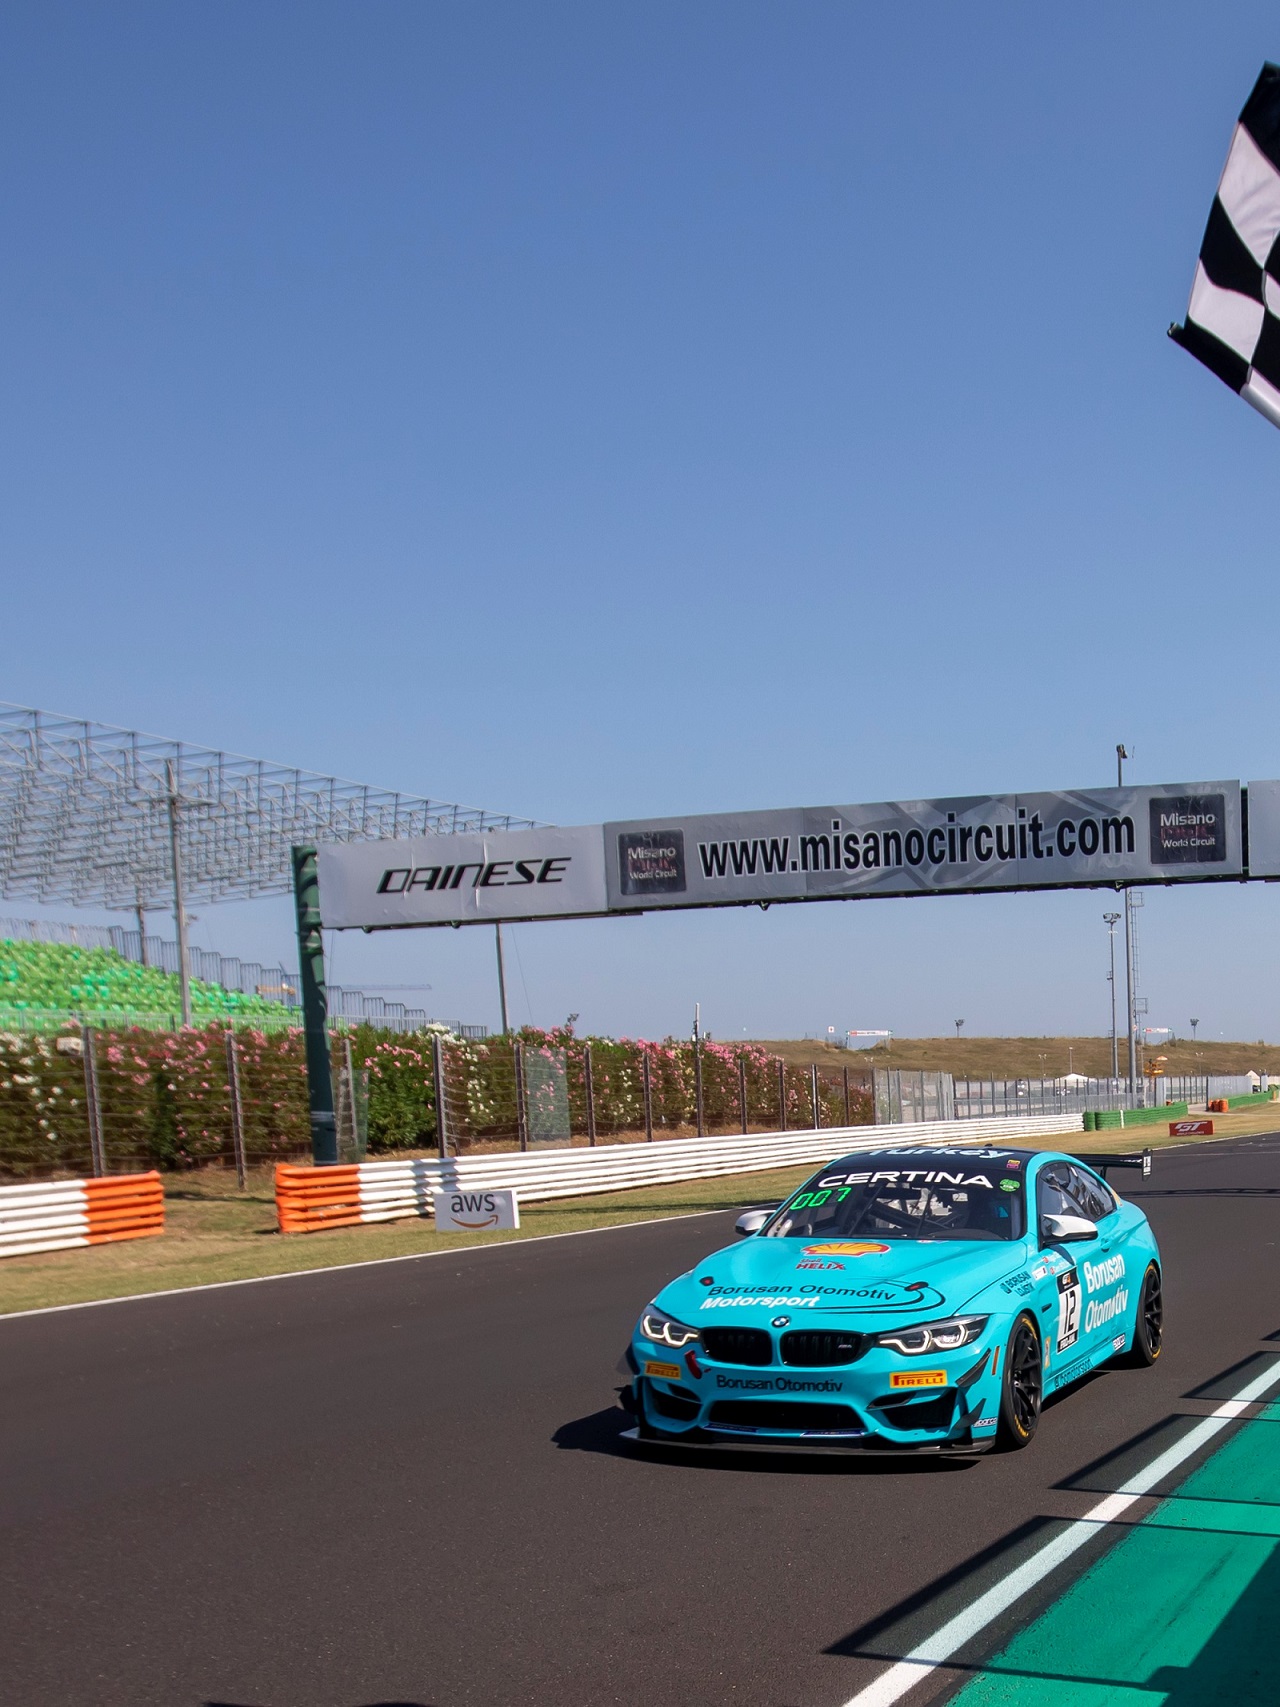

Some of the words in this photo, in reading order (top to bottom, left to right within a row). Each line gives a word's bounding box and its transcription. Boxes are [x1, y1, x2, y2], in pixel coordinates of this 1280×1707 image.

[1160, 813, 1215, 826] Misano
[698, 807, 1136, 878] www.misanocircuit.com
[1162, 839, 1188, 848] World
[1190, 837, 1215, 846] Circuit
[628, 847, 676, 860] Misano
[376, 857, 571, 894] DAINESE
[630, 872, 653, 880] World
[655, 868, 677, 878] Circuit
[1175, 1121, 1208, 1132] GT
[818, 1170, 994, 1189] CERTINA
[451, 1194, 495, 1212] aws
[790, 1187, 851, 1210] 007
[796, 1262, 847, 1271] HELIX
[1083, 1254, 1126, 1294] Borusan
[708, 1285, 792, 1296] Borusan
[800, 1285, 896, 1300] Otomotiv
[700, 1296, 820, 1309] Motorsport
[1084, 1285, 1129, 1333] Otomotiv
[1064, 1289, 1077, 1335] 12
[717, 1375, 773, 1390] Borusan
[775, 1377, 843, 1392] Otomotiv
[893, 1372, 943, 1386] PIRELLI
